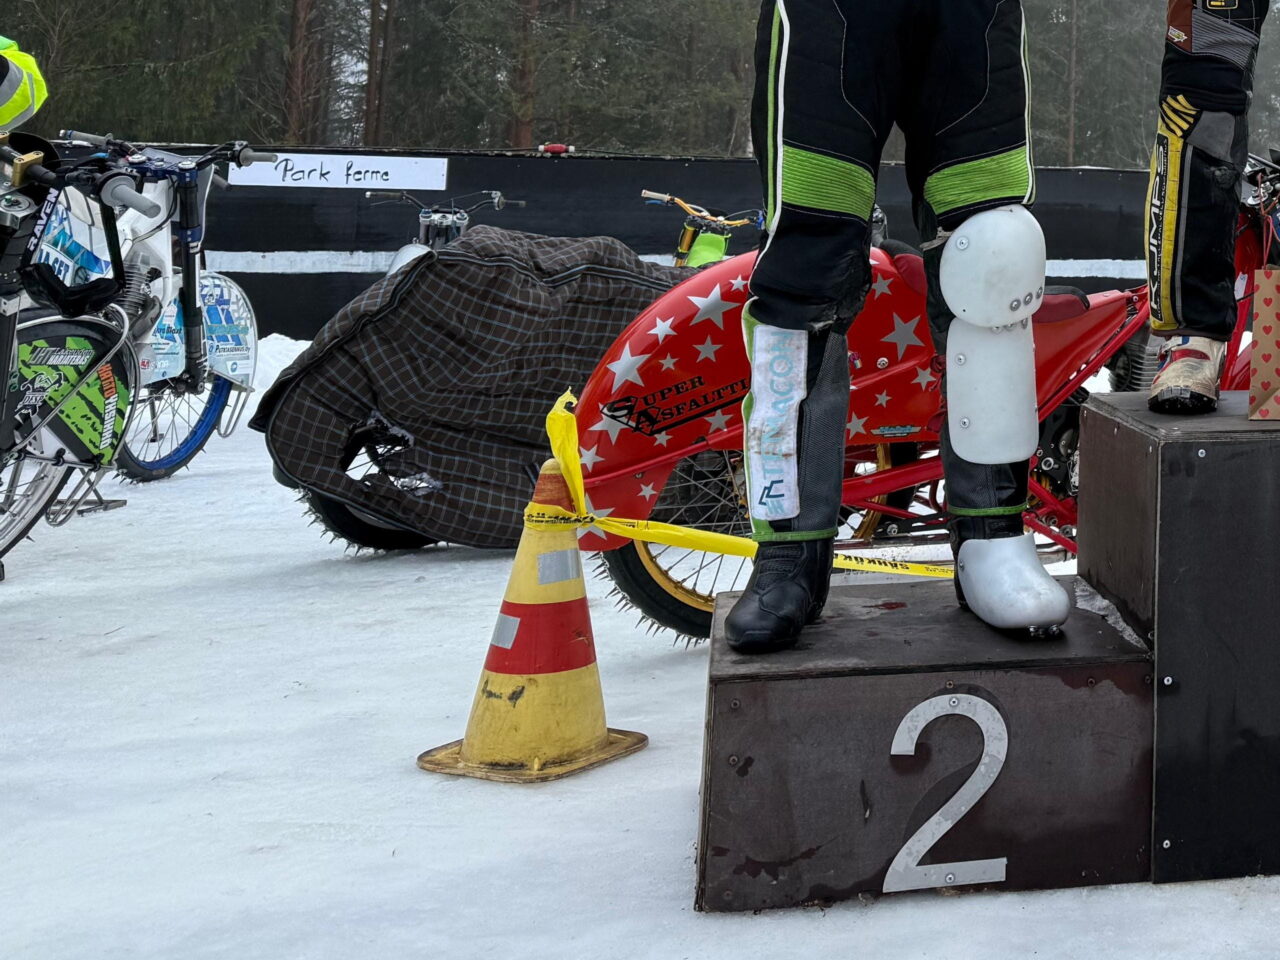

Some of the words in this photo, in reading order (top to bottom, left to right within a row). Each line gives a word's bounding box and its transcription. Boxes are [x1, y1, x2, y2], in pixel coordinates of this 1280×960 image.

[275, 158, 331, 182] Park
[345, 161, 389, 184] ferme
[27, 187, 59, 251] RAVEN
[882, 692, 1010, 893] 2
